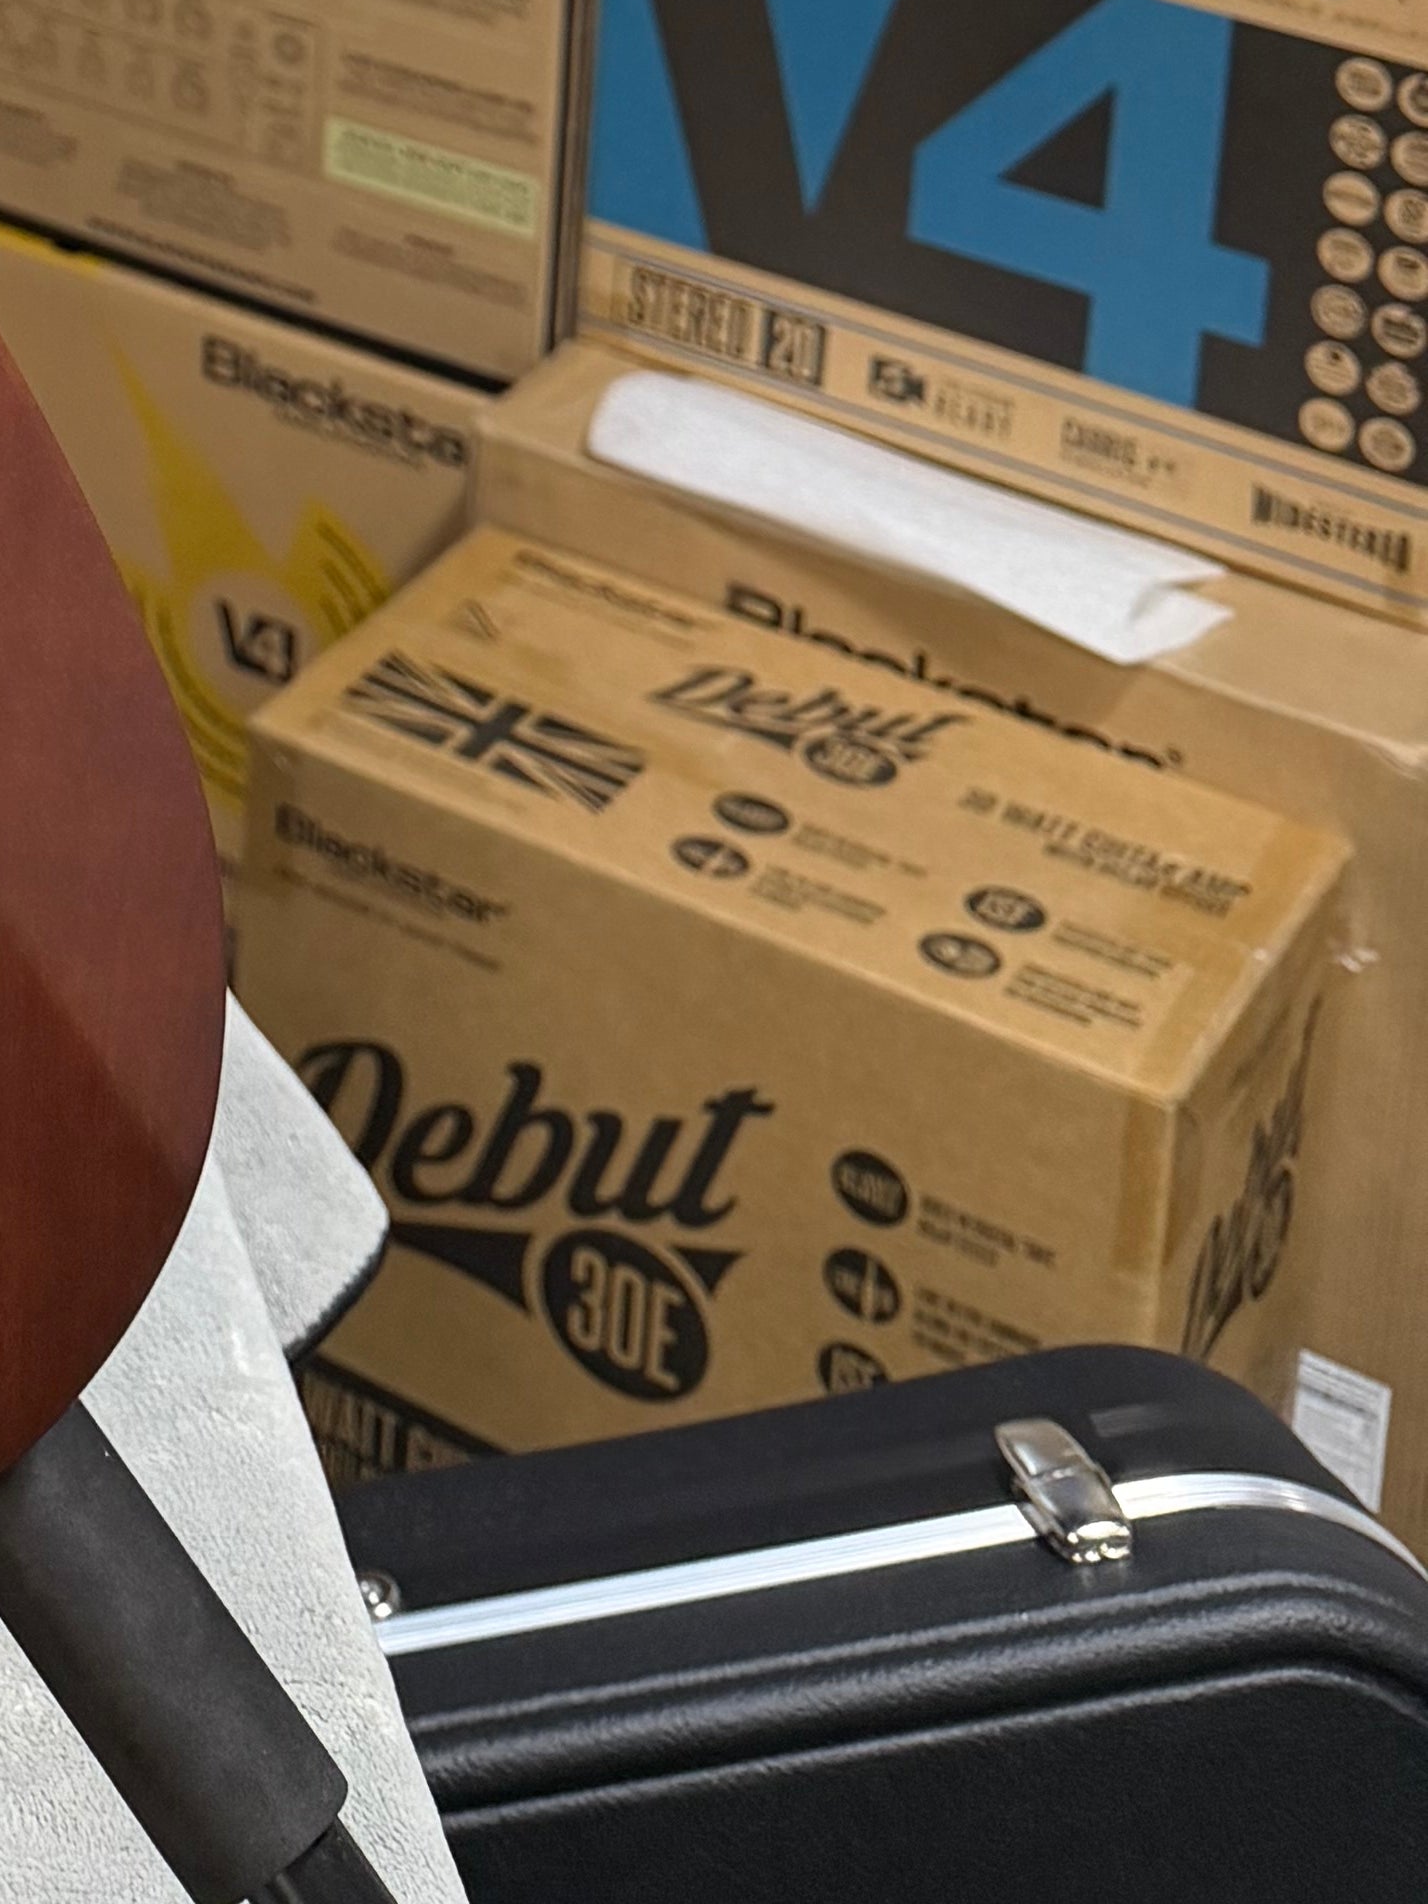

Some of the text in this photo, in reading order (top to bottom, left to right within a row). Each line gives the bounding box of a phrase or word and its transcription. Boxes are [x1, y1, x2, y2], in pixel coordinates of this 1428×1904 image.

[626, 265, 752, 366] STEREO
[275, 803, 510, 927] Blackstar
[566, 1246, 684, 1395] 30E
